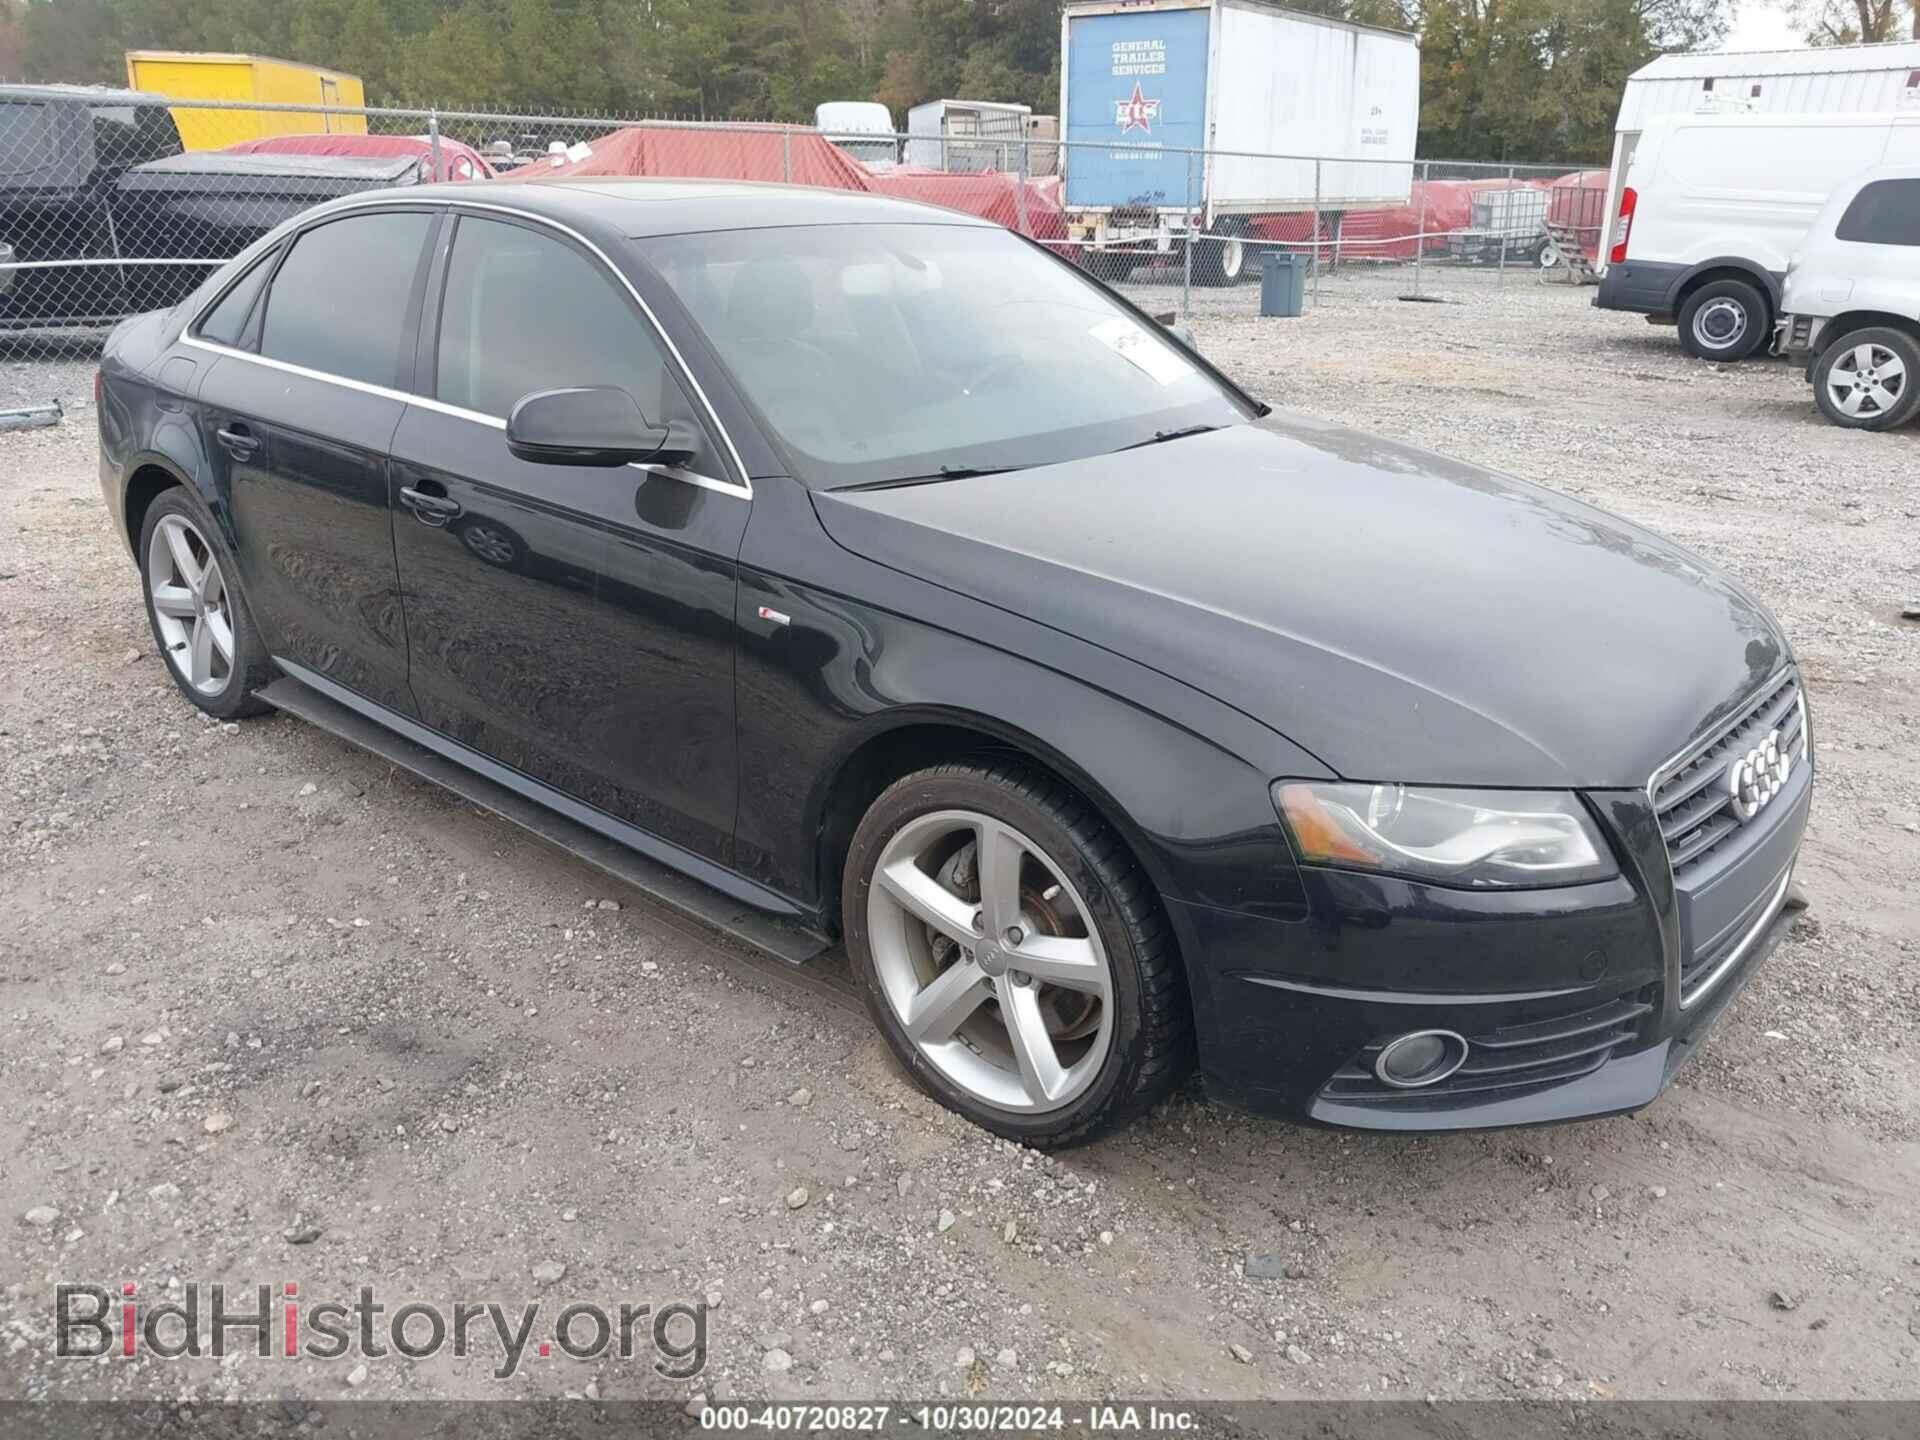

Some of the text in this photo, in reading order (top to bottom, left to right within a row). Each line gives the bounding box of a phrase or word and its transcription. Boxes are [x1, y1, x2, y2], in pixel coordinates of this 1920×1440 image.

[1112, 39, 1166, 52] GENERAL
[1112, 51, 1166, 64] TRAILER
[1112, 63, 1166, 76] SERVICES
